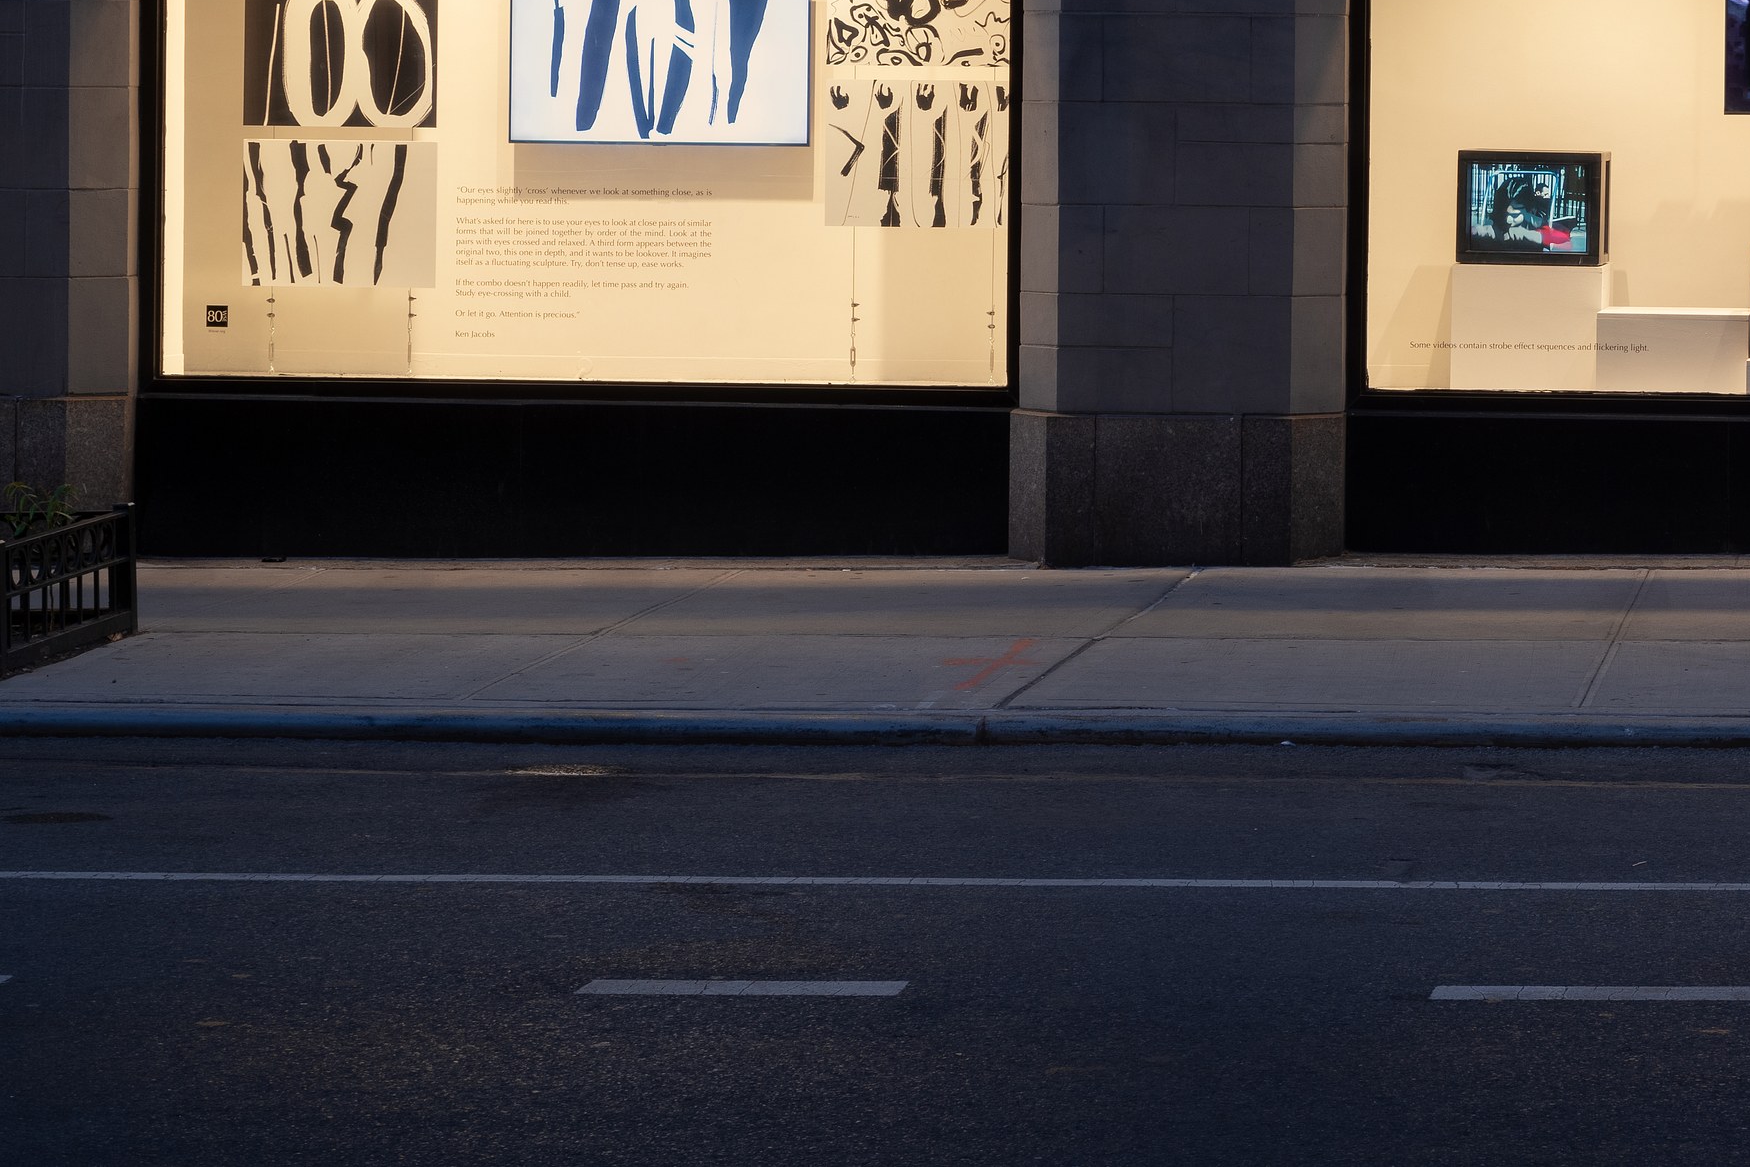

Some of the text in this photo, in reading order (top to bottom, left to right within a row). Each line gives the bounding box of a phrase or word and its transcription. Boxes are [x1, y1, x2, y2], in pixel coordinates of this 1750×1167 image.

[478, 188, 494, 196] eyes
[496, 186, 522, 197] slightly
[551, 186, 587, 195] whenever
[603, 187, 620, 195] look
[631, 187, 670, 198] something
[672, 188, 693, 197] close,
[456, 196, 569, 208] happening while you read this.
[456, 258, 473, 266] itself
[492, 258, 531, 269] fluctuating
[532, 259, 568, 270] sculpture.
[571, 259, 583, 270] Try,
[628, 262, 640, 270] up,
[660, 260, 684, 268] works.
[455, 278, 461, 287] If
[463, 278, 474, 287] the
[476, 279, 502, 287] combo
[532, 279, 560, 290] happen
[562, 280, 588, 290] readily,
[591, 280, 601, 288] let
[621, 283, 637, 291] pass
[639, 280, 653, 289] and
[655, 281, 664, 291] try
[667, 281, 689, 292] again.
[455, 289, 476, 300] Study
[478, 290, 524, 300] eye-crossing
[525, 290, 542, 298] with
[550, 290, 571, 299] child.
[208, 310, 223, 322] 80
[455, 309, 465, 318] Or
[467, 309, 477, 318] let
[485, 312, 496, 320] go.
[499, 310, 533, 318] Attention
[455, 330, 495, 340] Ken Jacobs
[1410, 340, 1431, 349] Some
[1433, 340, 1457, 349] videos
[1489, 341, 1512, 349] strobe
[1514, 341, 1535, 349] effect
[1537, 344, 1575, 352] sequences
[1578, 341, 1592, 350] and
[1594, 342, 1628, 352] flickering
[1630, 342, 1648, 352] light.
